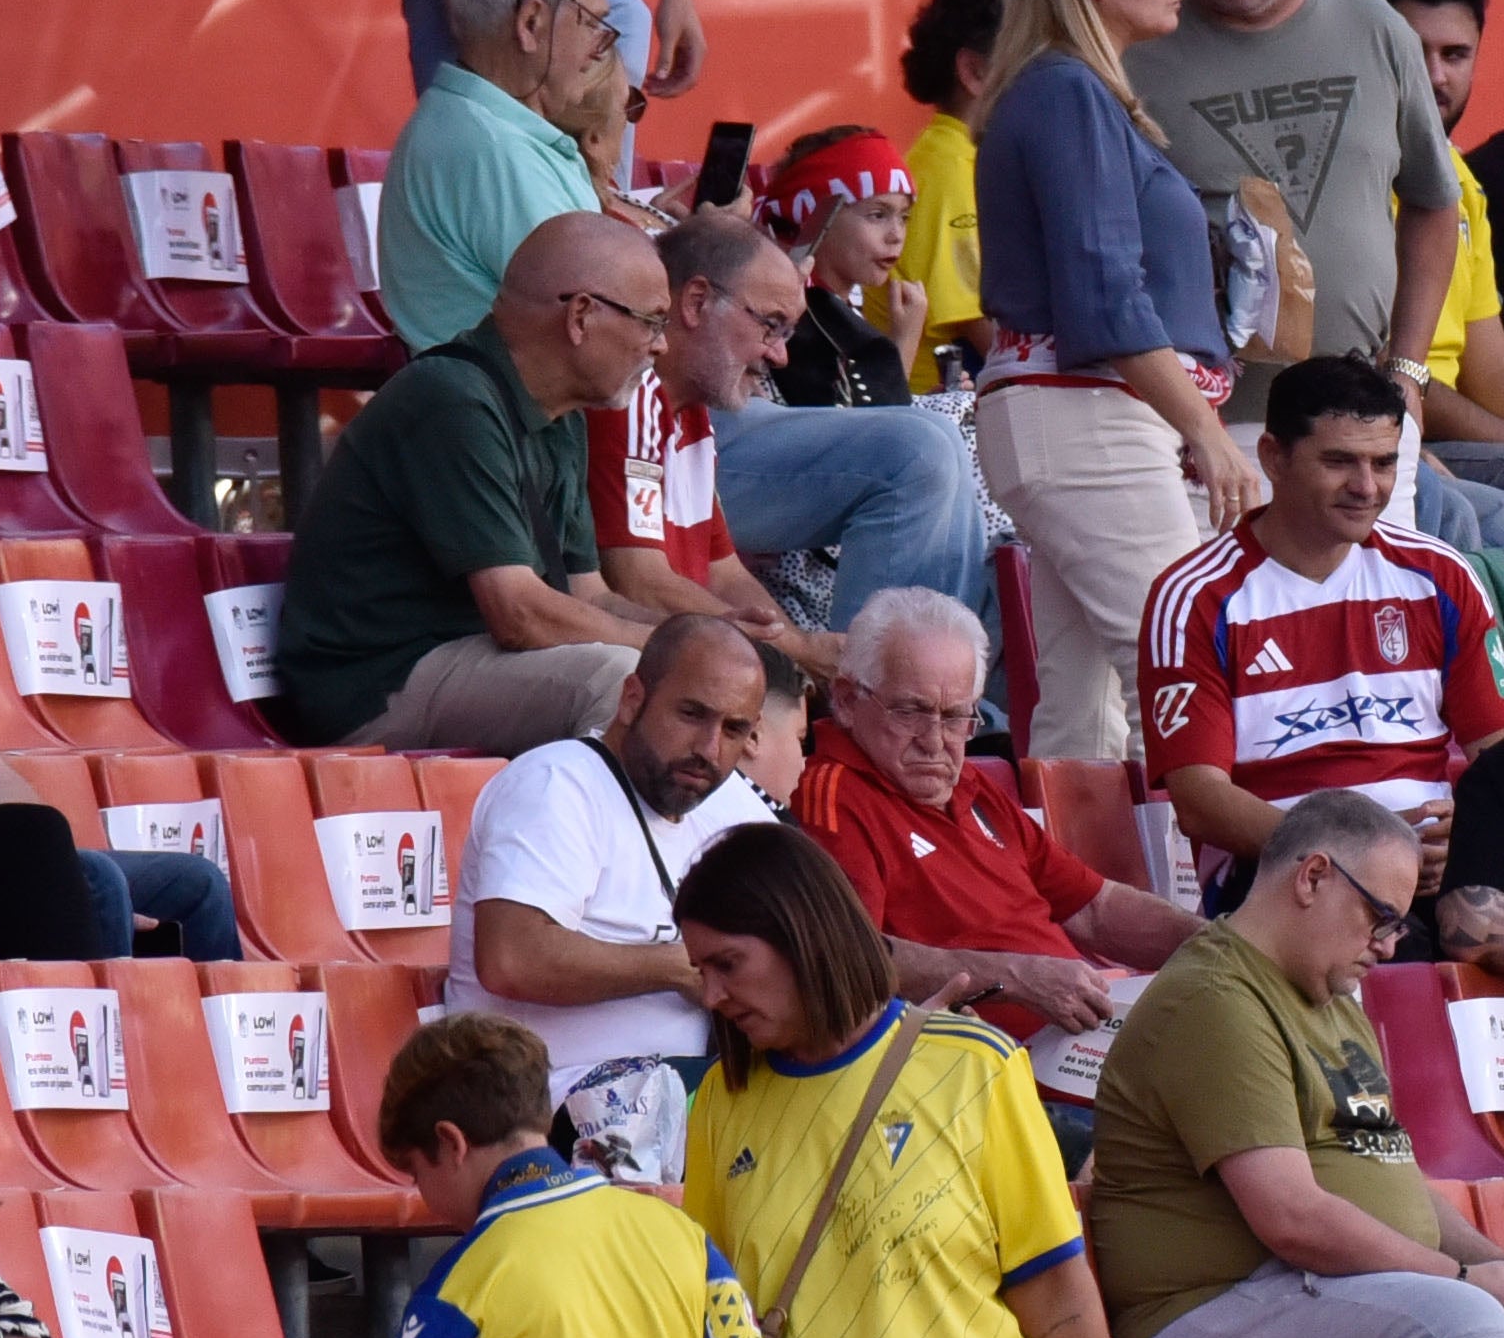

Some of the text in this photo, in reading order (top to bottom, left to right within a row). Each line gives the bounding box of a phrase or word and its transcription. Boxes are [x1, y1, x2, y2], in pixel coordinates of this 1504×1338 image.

[1190, 75, 1358, 128] GUESS
[1078, 1057, 1098, 1068] vivir
[1058, 1065, 1085, 1078] como
